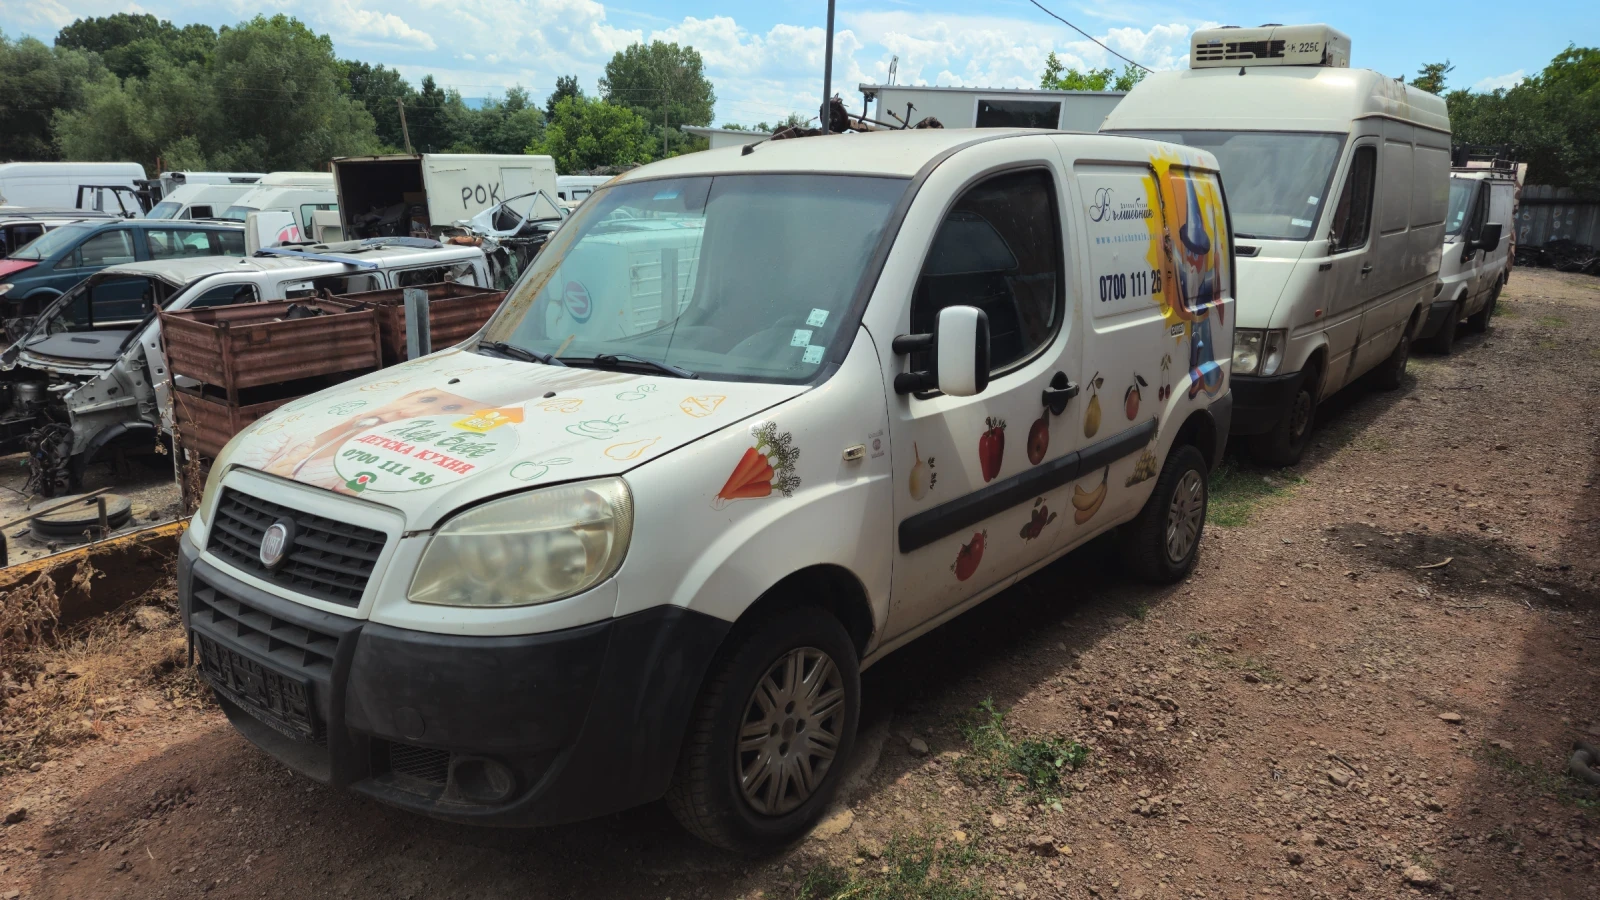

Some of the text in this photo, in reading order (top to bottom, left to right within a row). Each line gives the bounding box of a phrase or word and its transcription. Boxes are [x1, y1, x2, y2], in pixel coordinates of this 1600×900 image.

[1099, 269, 1162, 302] 0700 111 26
[342, 448, 435, 486] 0700 111 26
[354, 434, 475, 475] ДЕТСКА КУХНЯ
